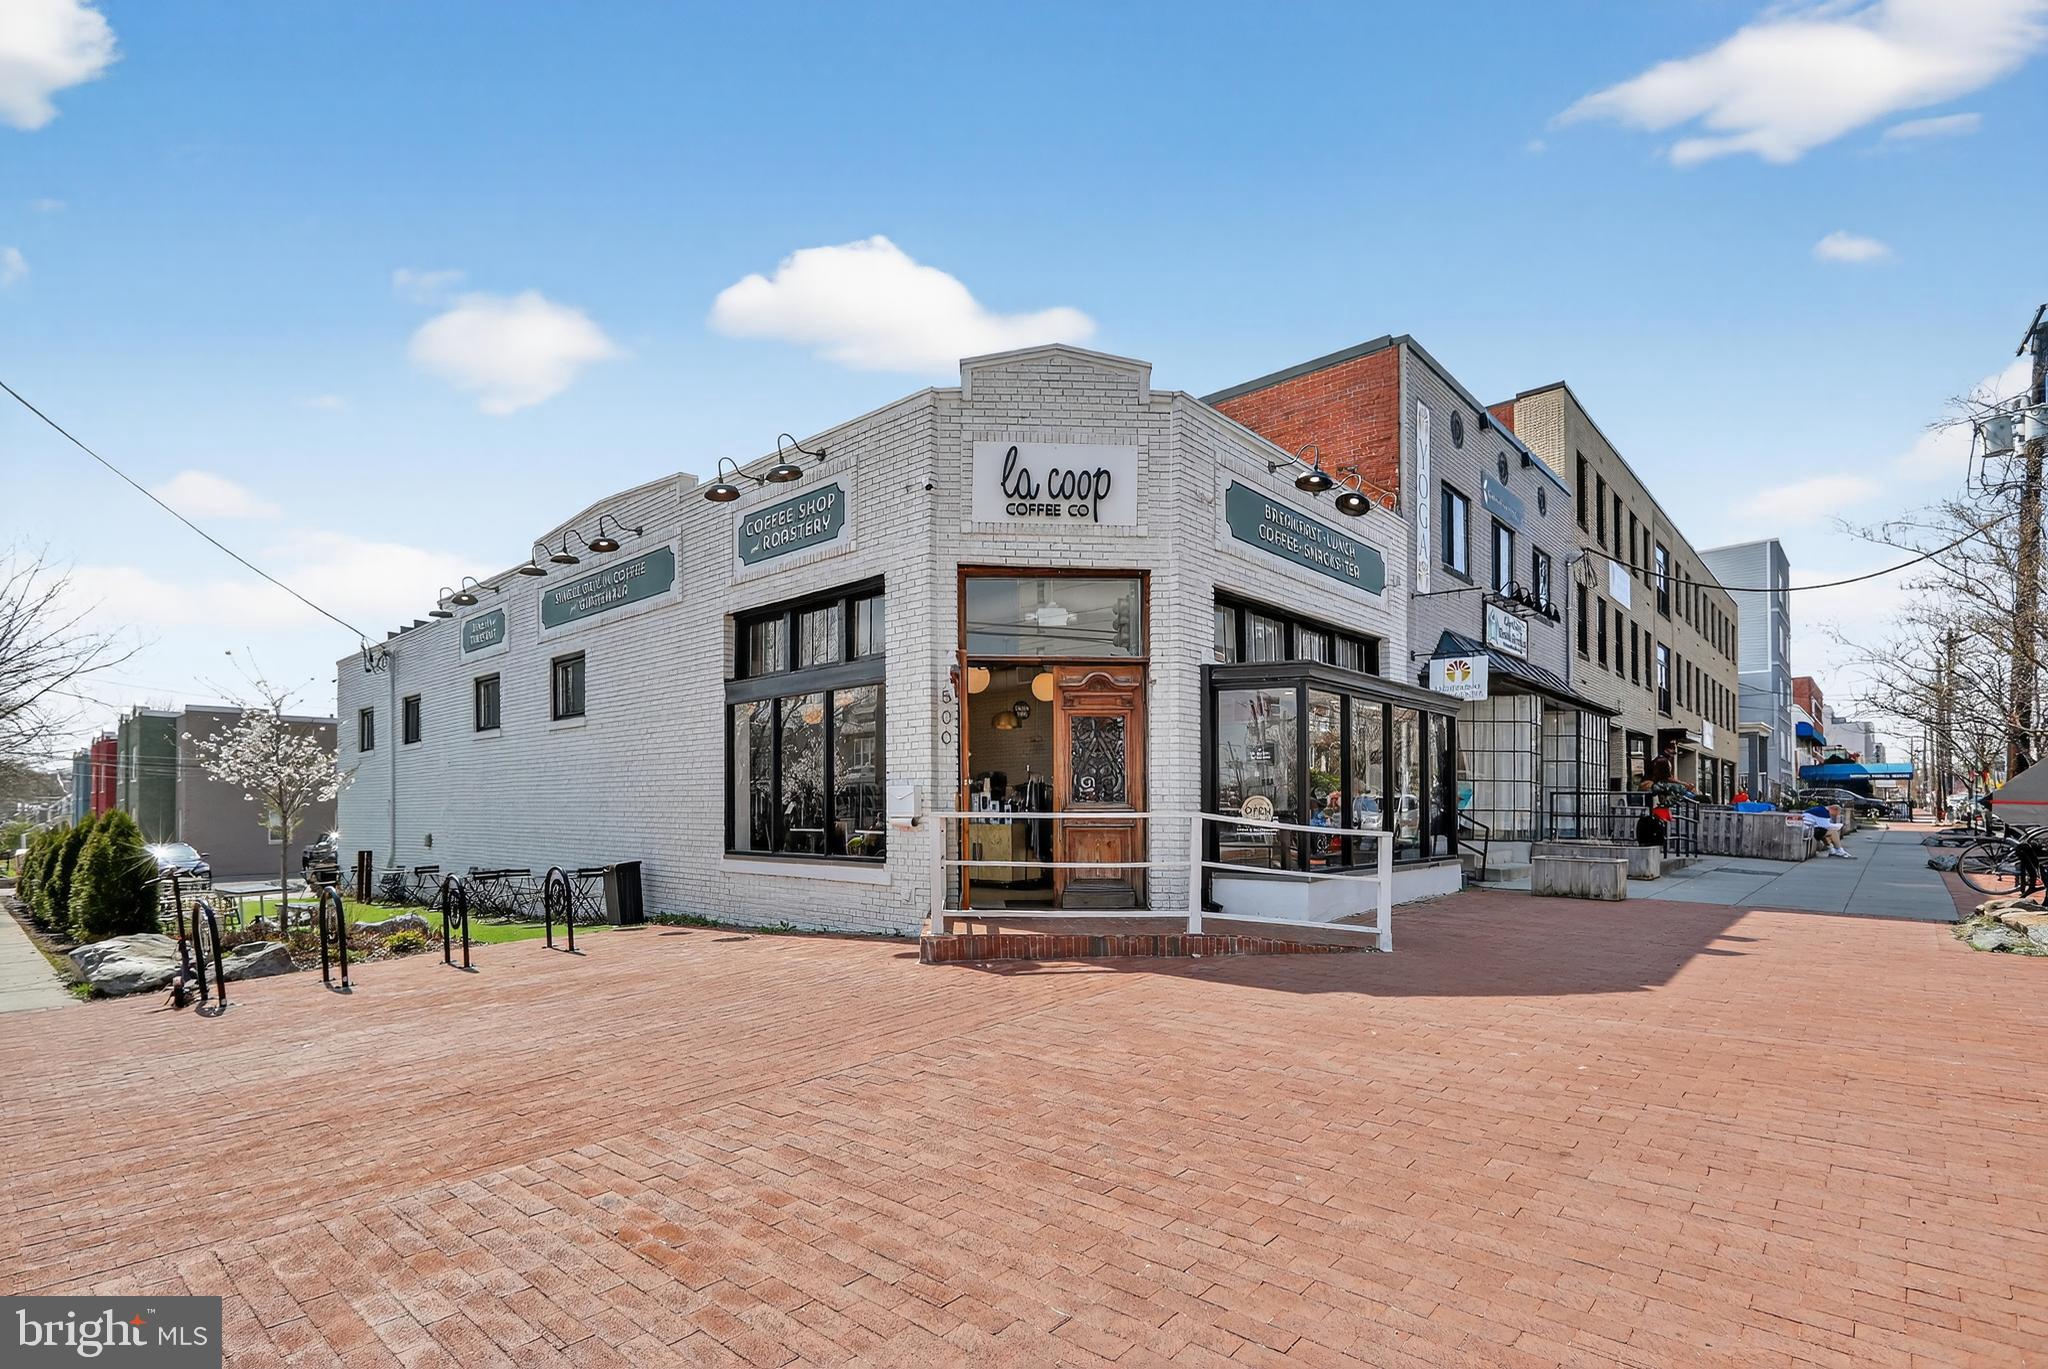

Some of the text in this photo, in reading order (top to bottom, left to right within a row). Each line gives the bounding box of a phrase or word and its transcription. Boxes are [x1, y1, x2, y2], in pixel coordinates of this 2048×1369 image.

[1000, 445, 1112, 523] la coop
[1005, 502, 1090, 517] COFFEE CO
[1418, 437, 1429, 561] YOGA
[746, 493, 835, 536] COFFEE SHOP
[763, 513, 831, 551] ROASTERY
[1258, 524, 1361, 581] COFFEE SNACKS TEA
[941, 690, 952, 745] 500
